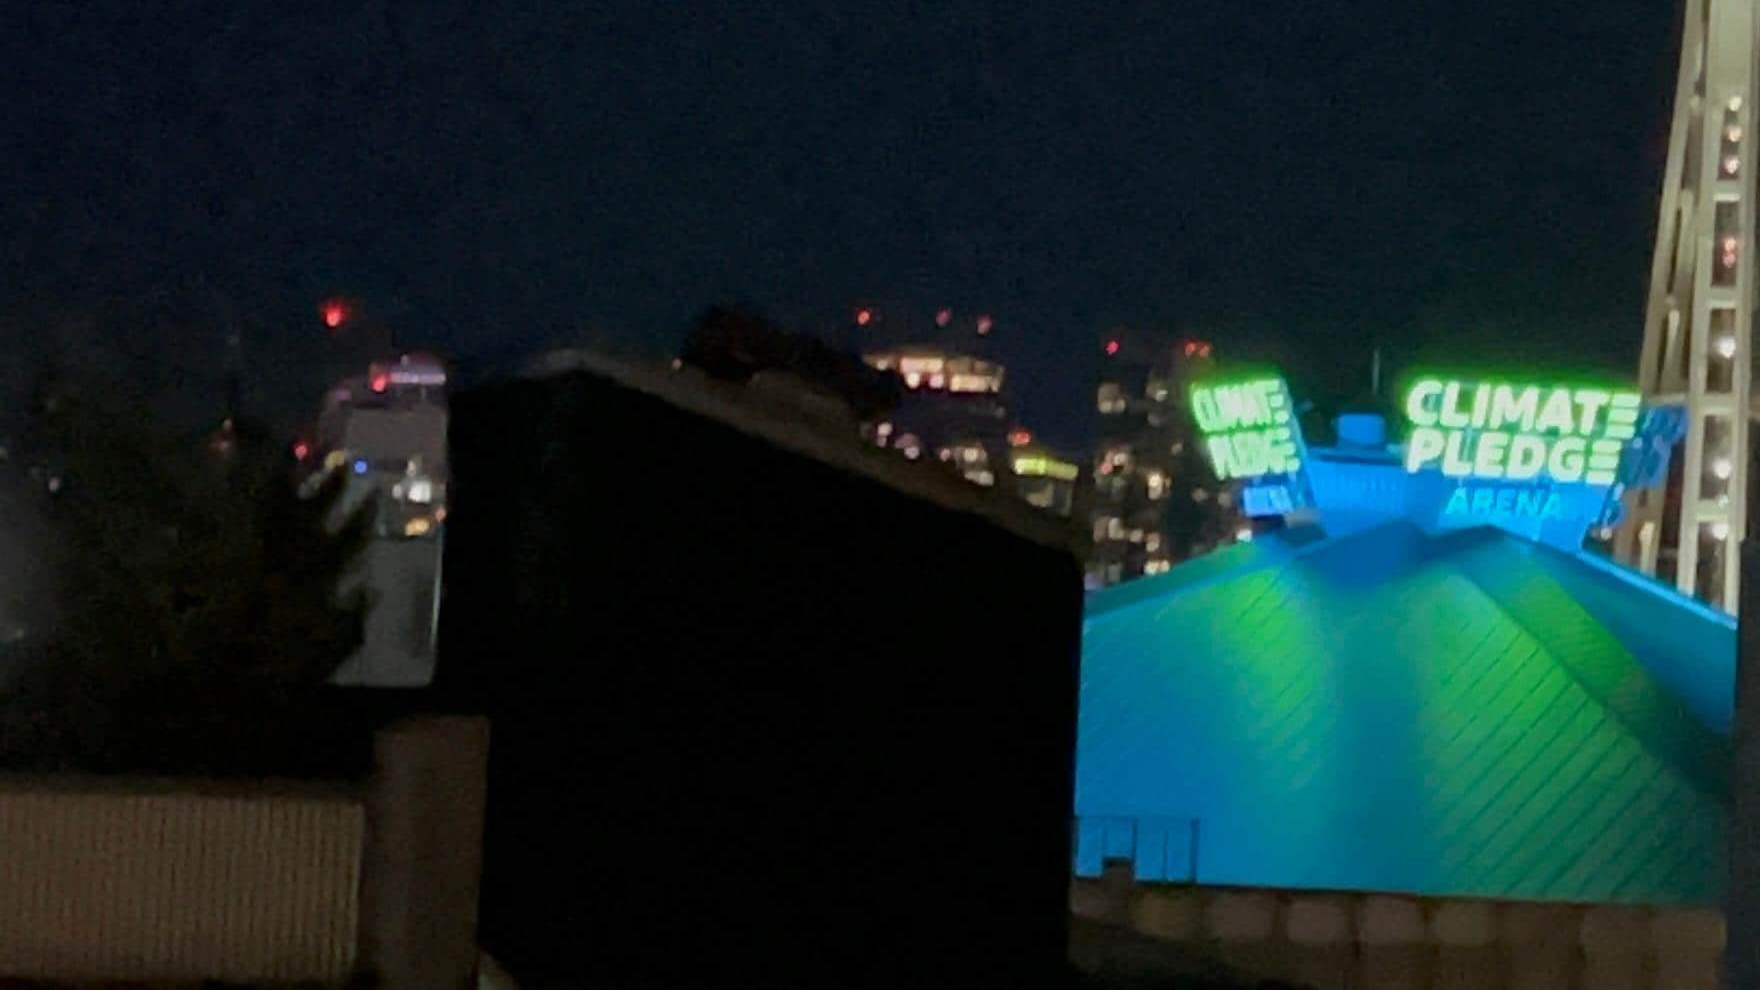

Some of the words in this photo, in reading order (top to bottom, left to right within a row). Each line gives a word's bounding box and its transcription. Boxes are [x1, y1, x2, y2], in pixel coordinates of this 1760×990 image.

[1406, 380, 1641, 440] CLIMATE
[1407, 429, 1622, 484] PLEDGE
[1445, 488, 1562, 519] ARENA
